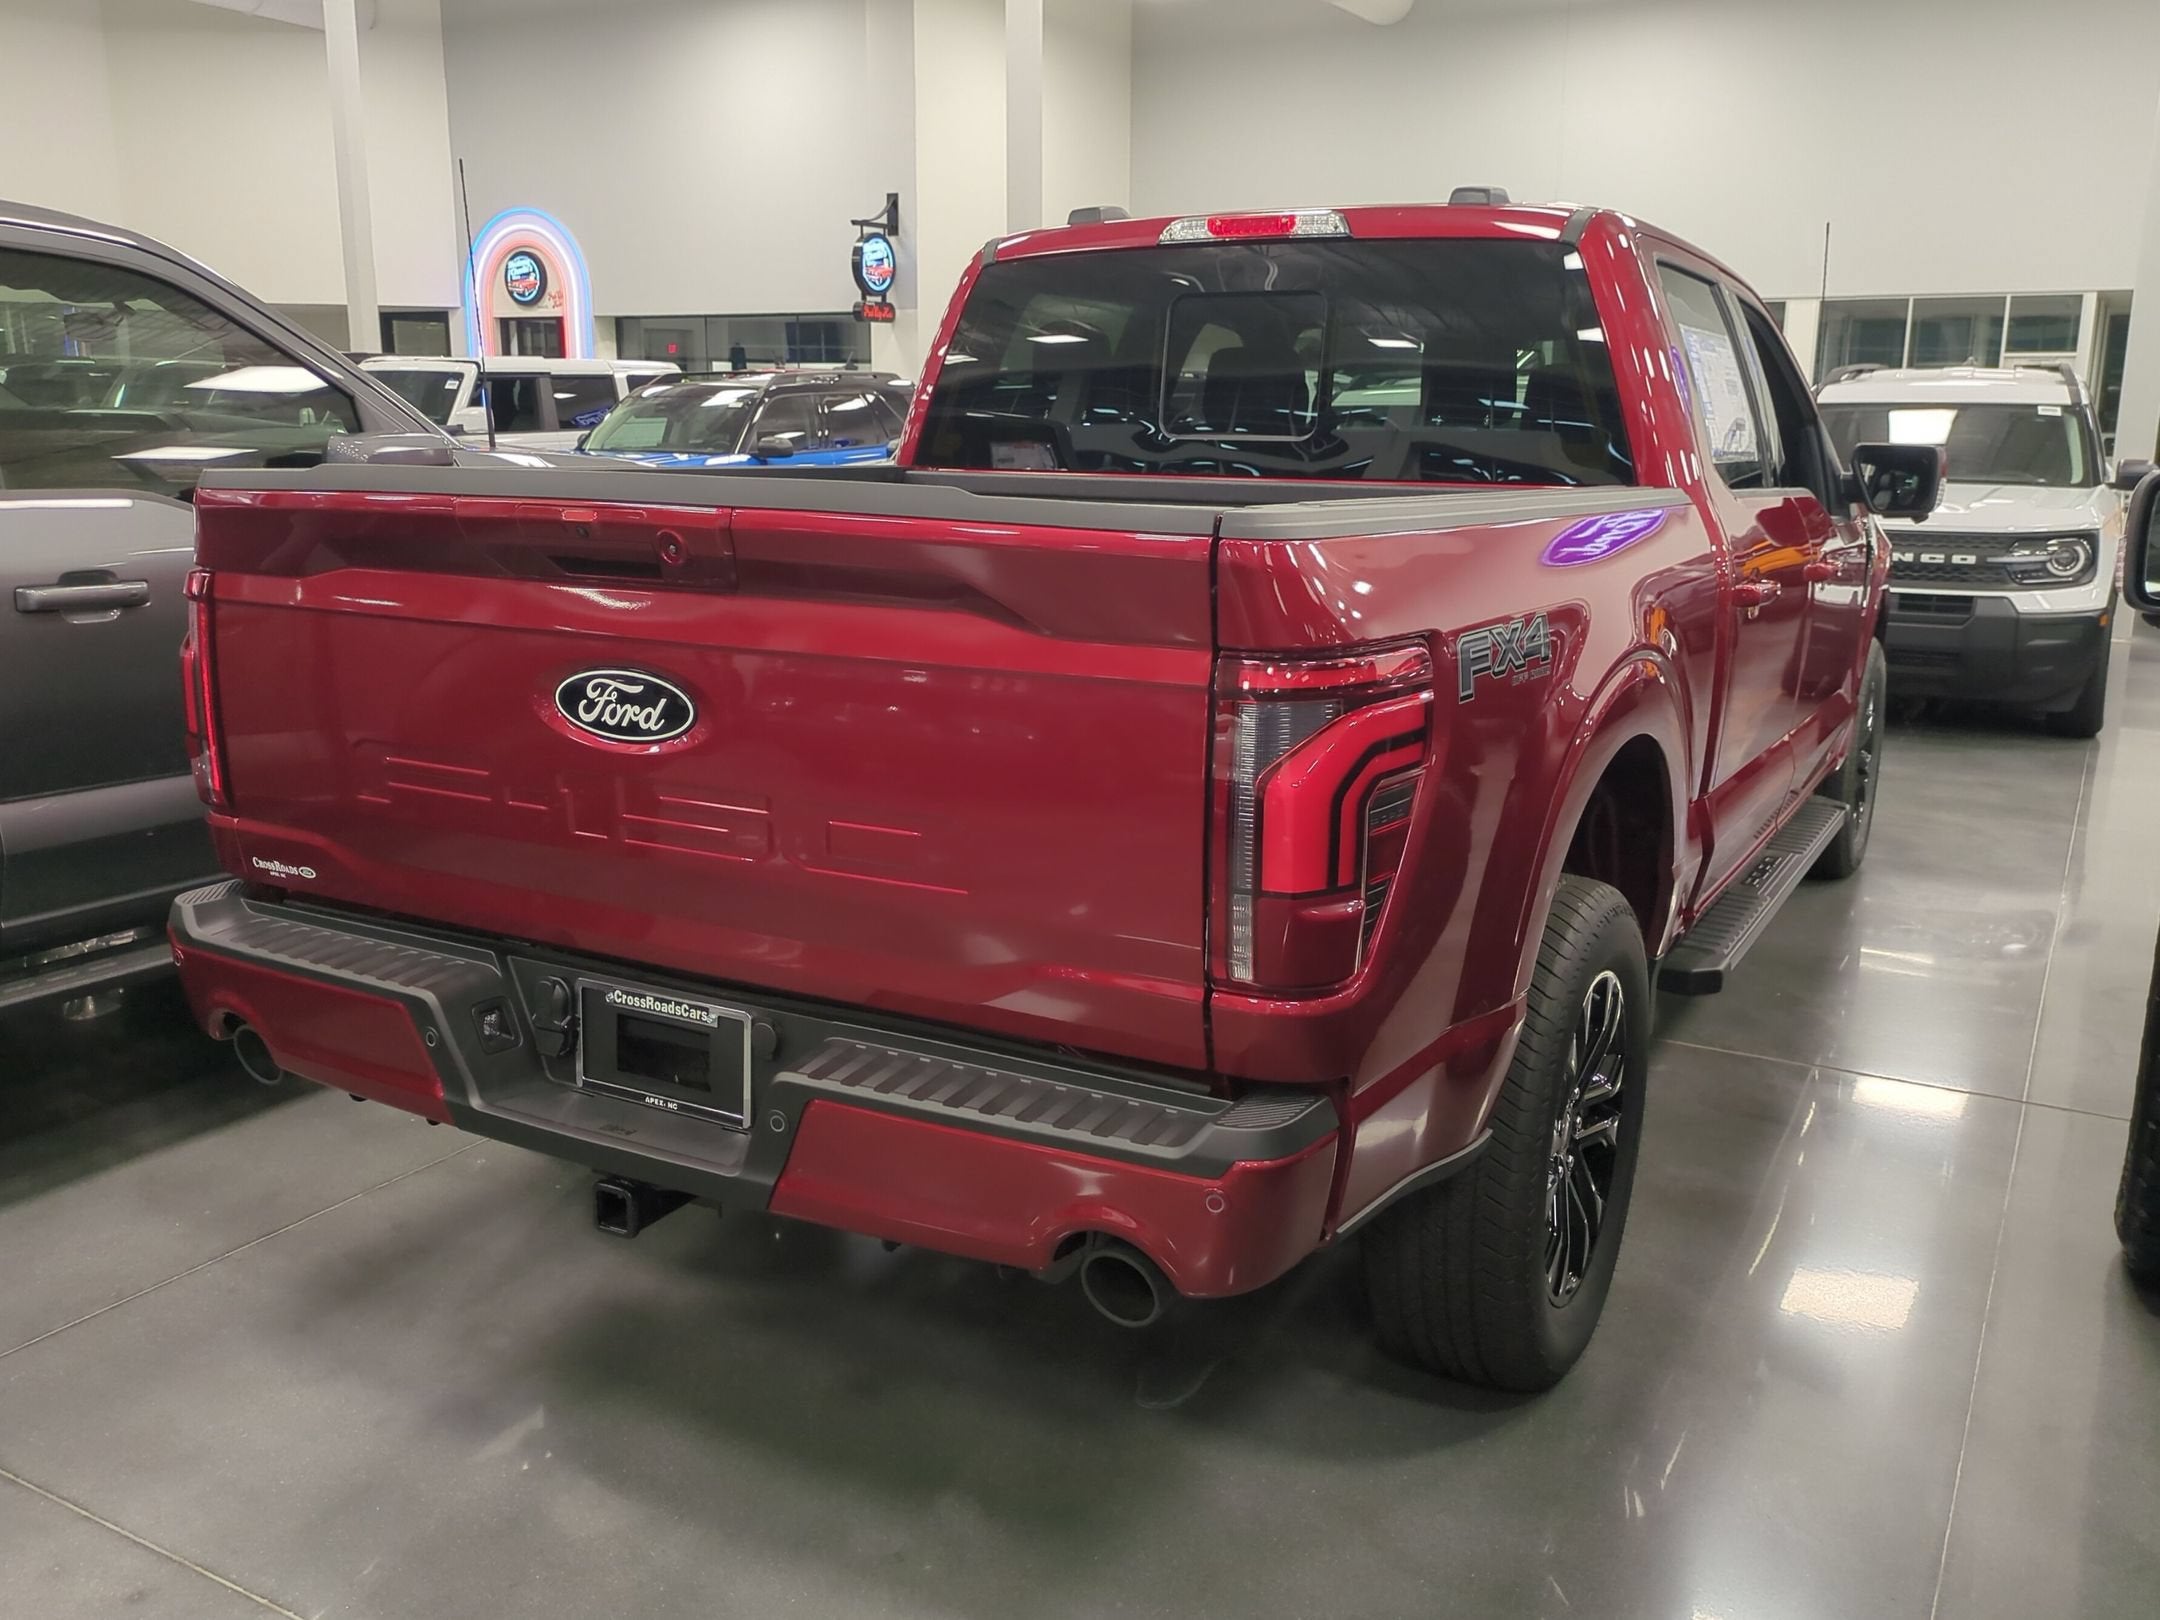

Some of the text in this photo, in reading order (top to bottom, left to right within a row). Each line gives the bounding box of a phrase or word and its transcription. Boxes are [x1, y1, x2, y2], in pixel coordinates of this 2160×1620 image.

[1892, 552, 1977, 565] NCO
[1457, 611, 1551, 704] FX4
[578, 678, 667, 731] Ford
